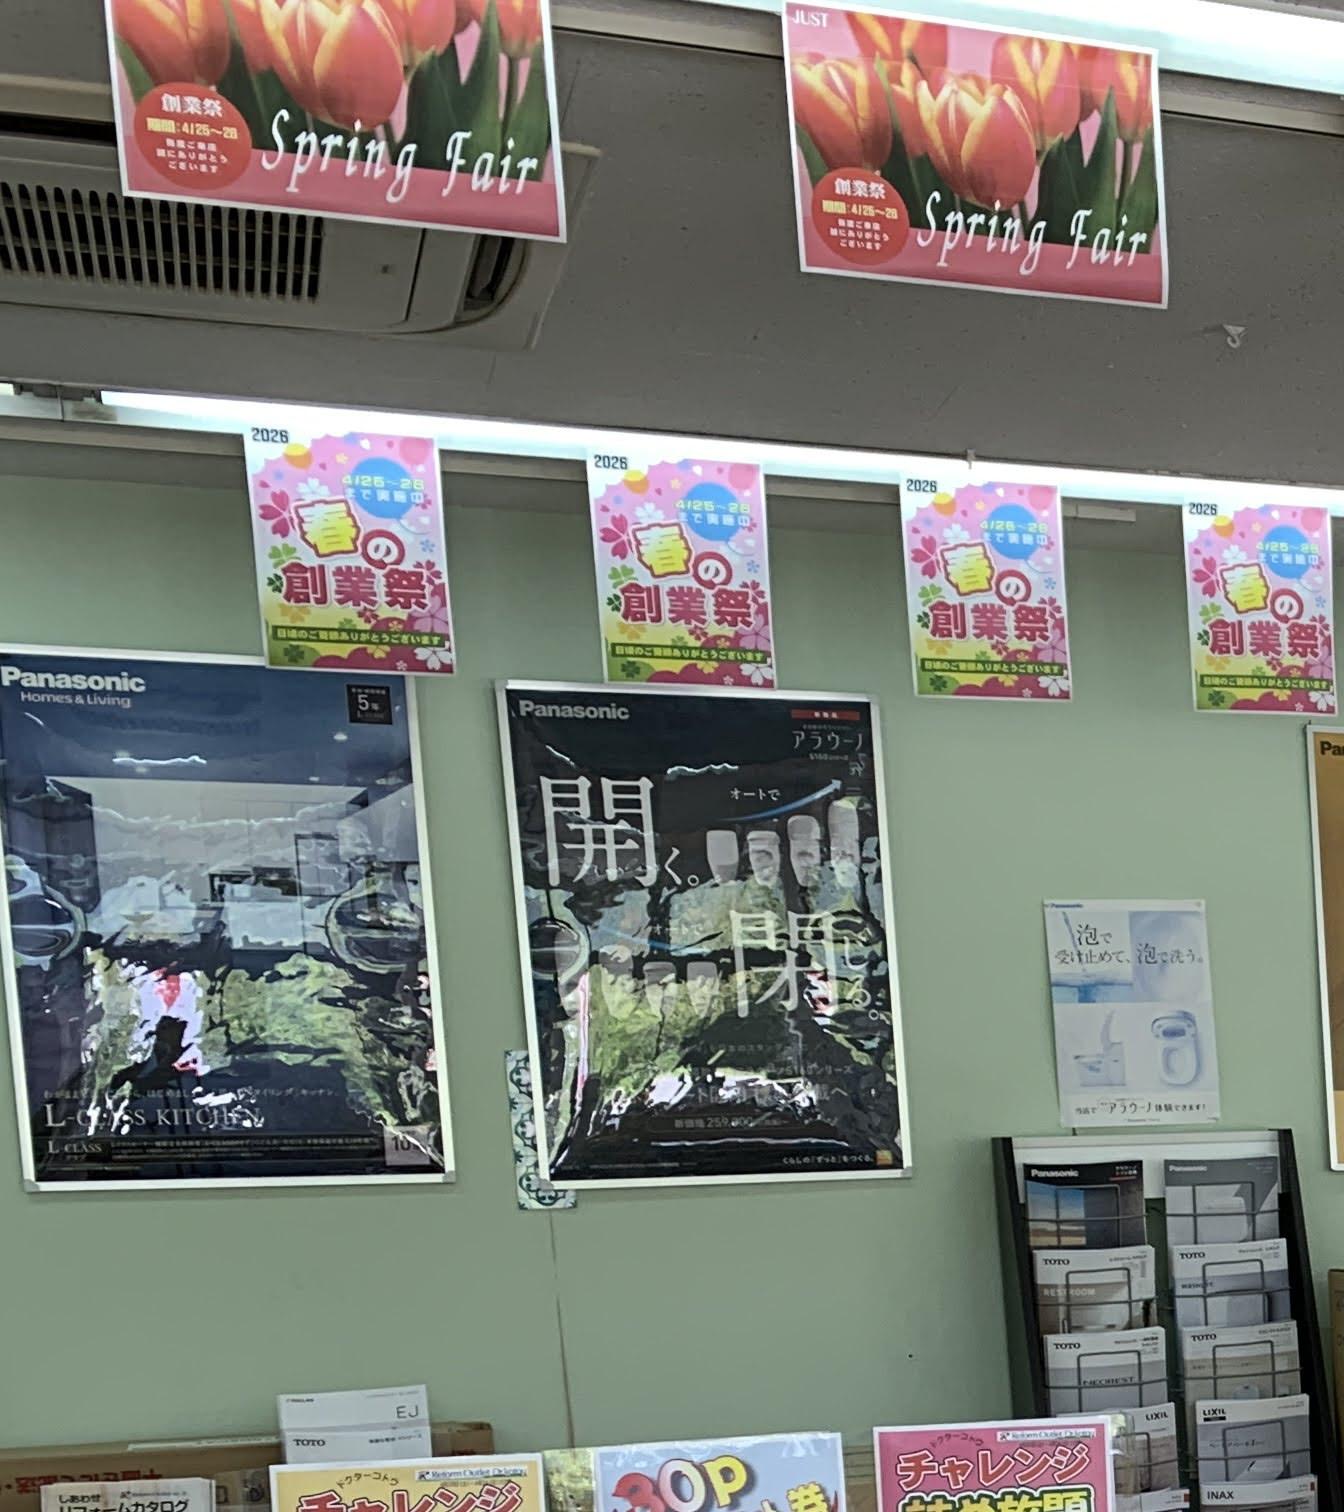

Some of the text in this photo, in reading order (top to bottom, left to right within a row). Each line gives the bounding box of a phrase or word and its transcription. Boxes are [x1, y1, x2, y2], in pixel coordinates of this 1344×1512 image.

[791, 9, 829, 28] JUST
[161, 93, 223, 118] 創業祭
[261, 109, 540, 203] Spring Fair
[834, 177, 886, 200] 創業祭
[917, 191, 1147, 275] Spring Fair
[252, 427, 289, 444] 2026
[594, 455, 628, 470] 2026
[907, 478, 937, 493] 2026
[1189, 502, 1217, 516] 2026
[281, 562, 430, 611] 創業祭
[619, 582, 754, 628] 創業祭
[929, 600, 1050, 642] 創業祭
[1208, 619, 1321, 659] 創業祭
[1, 666, 146, 693] Panasonic
[20, 691, 72, 705] Homes
[87, 693, 131, 709] Living
[519, 701, 630, 720] Panasonic
[730, 787, 781, 802] オートで
[1077, 924, 1113, 946] 泡で
[396, 1404, 420, 1419] EJ
[1145, 1411, 1169, 1421] LIXIL
[1202, 1407, 1227, 1417] LIXIL
[293, 1437, 327, 1448] TOTO
[897, 1442, 1090, 1490] チャレンジ
[1207, 1490, 1234, 1500] INAX
